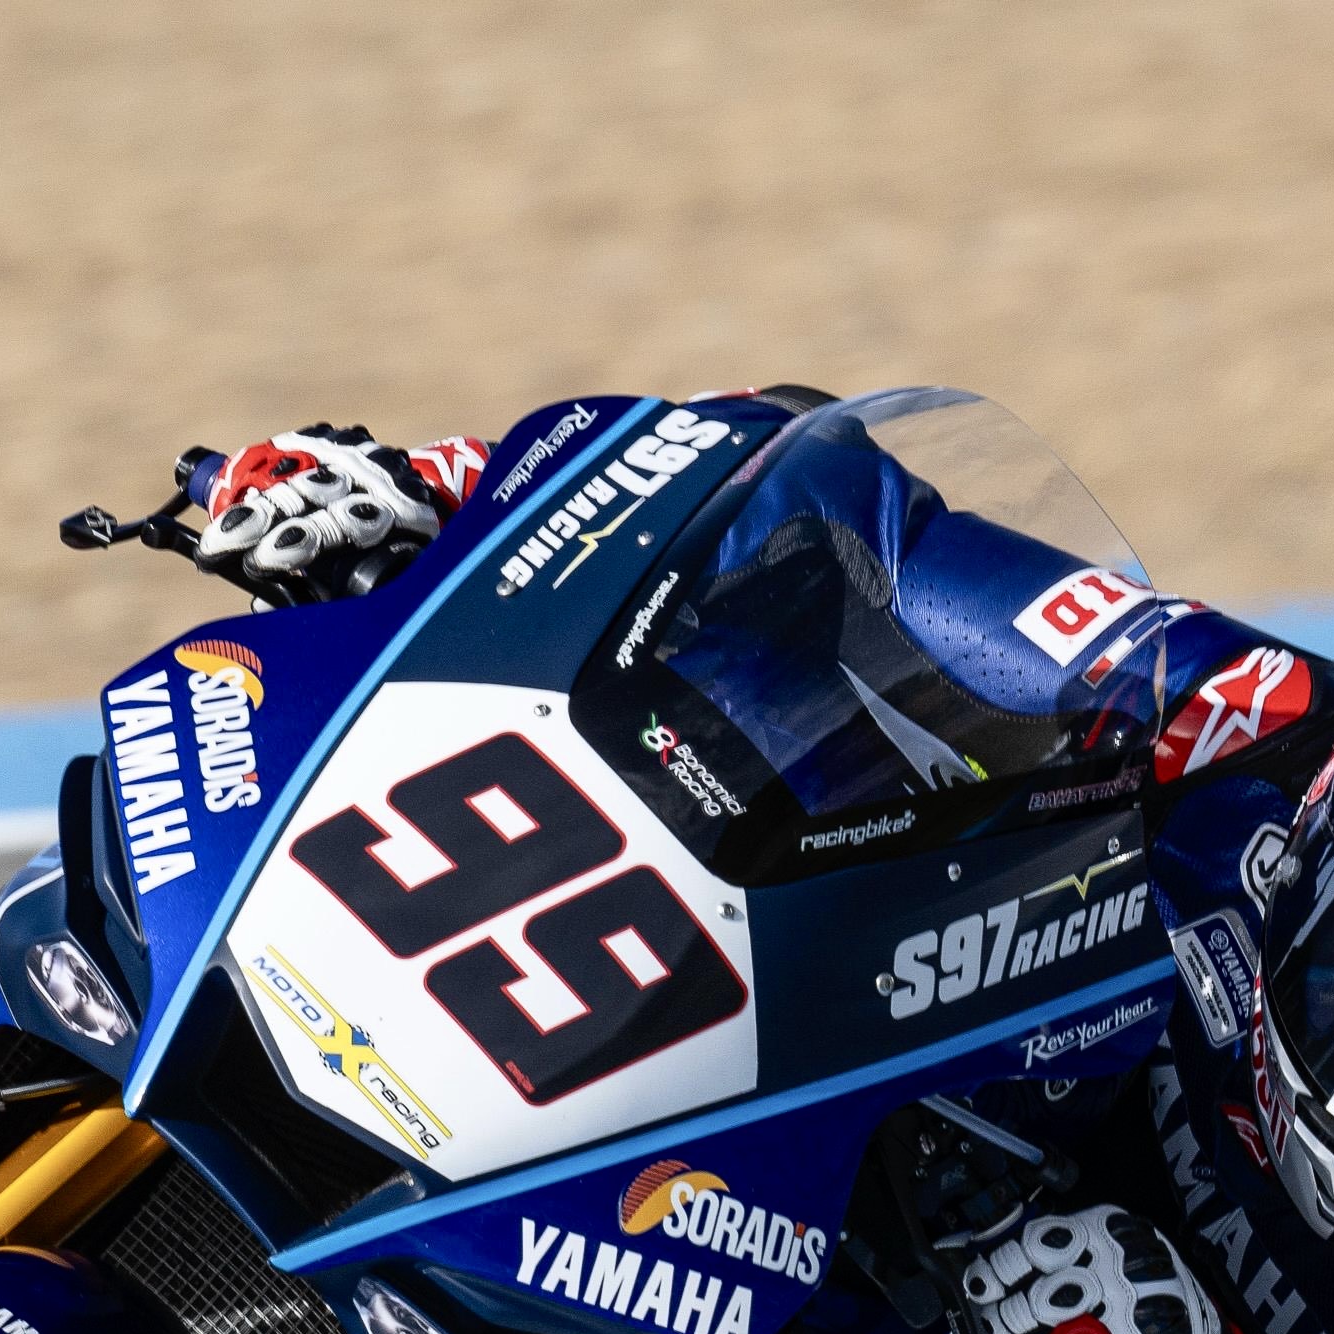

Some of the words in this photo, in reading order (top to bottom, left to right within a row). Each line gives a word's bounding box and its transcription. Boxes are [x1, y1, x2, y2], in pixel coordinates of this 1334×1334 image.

[107, 670, 196, 895] YAMAHA
[668, 760, 721, 817] Racing
[674, 743, 747, 816] Bonamici
[288, 731, 748, 1106] 99
[253, 956, 322, 1022] MOTO
[370, 1076, 441, 1149] racing
